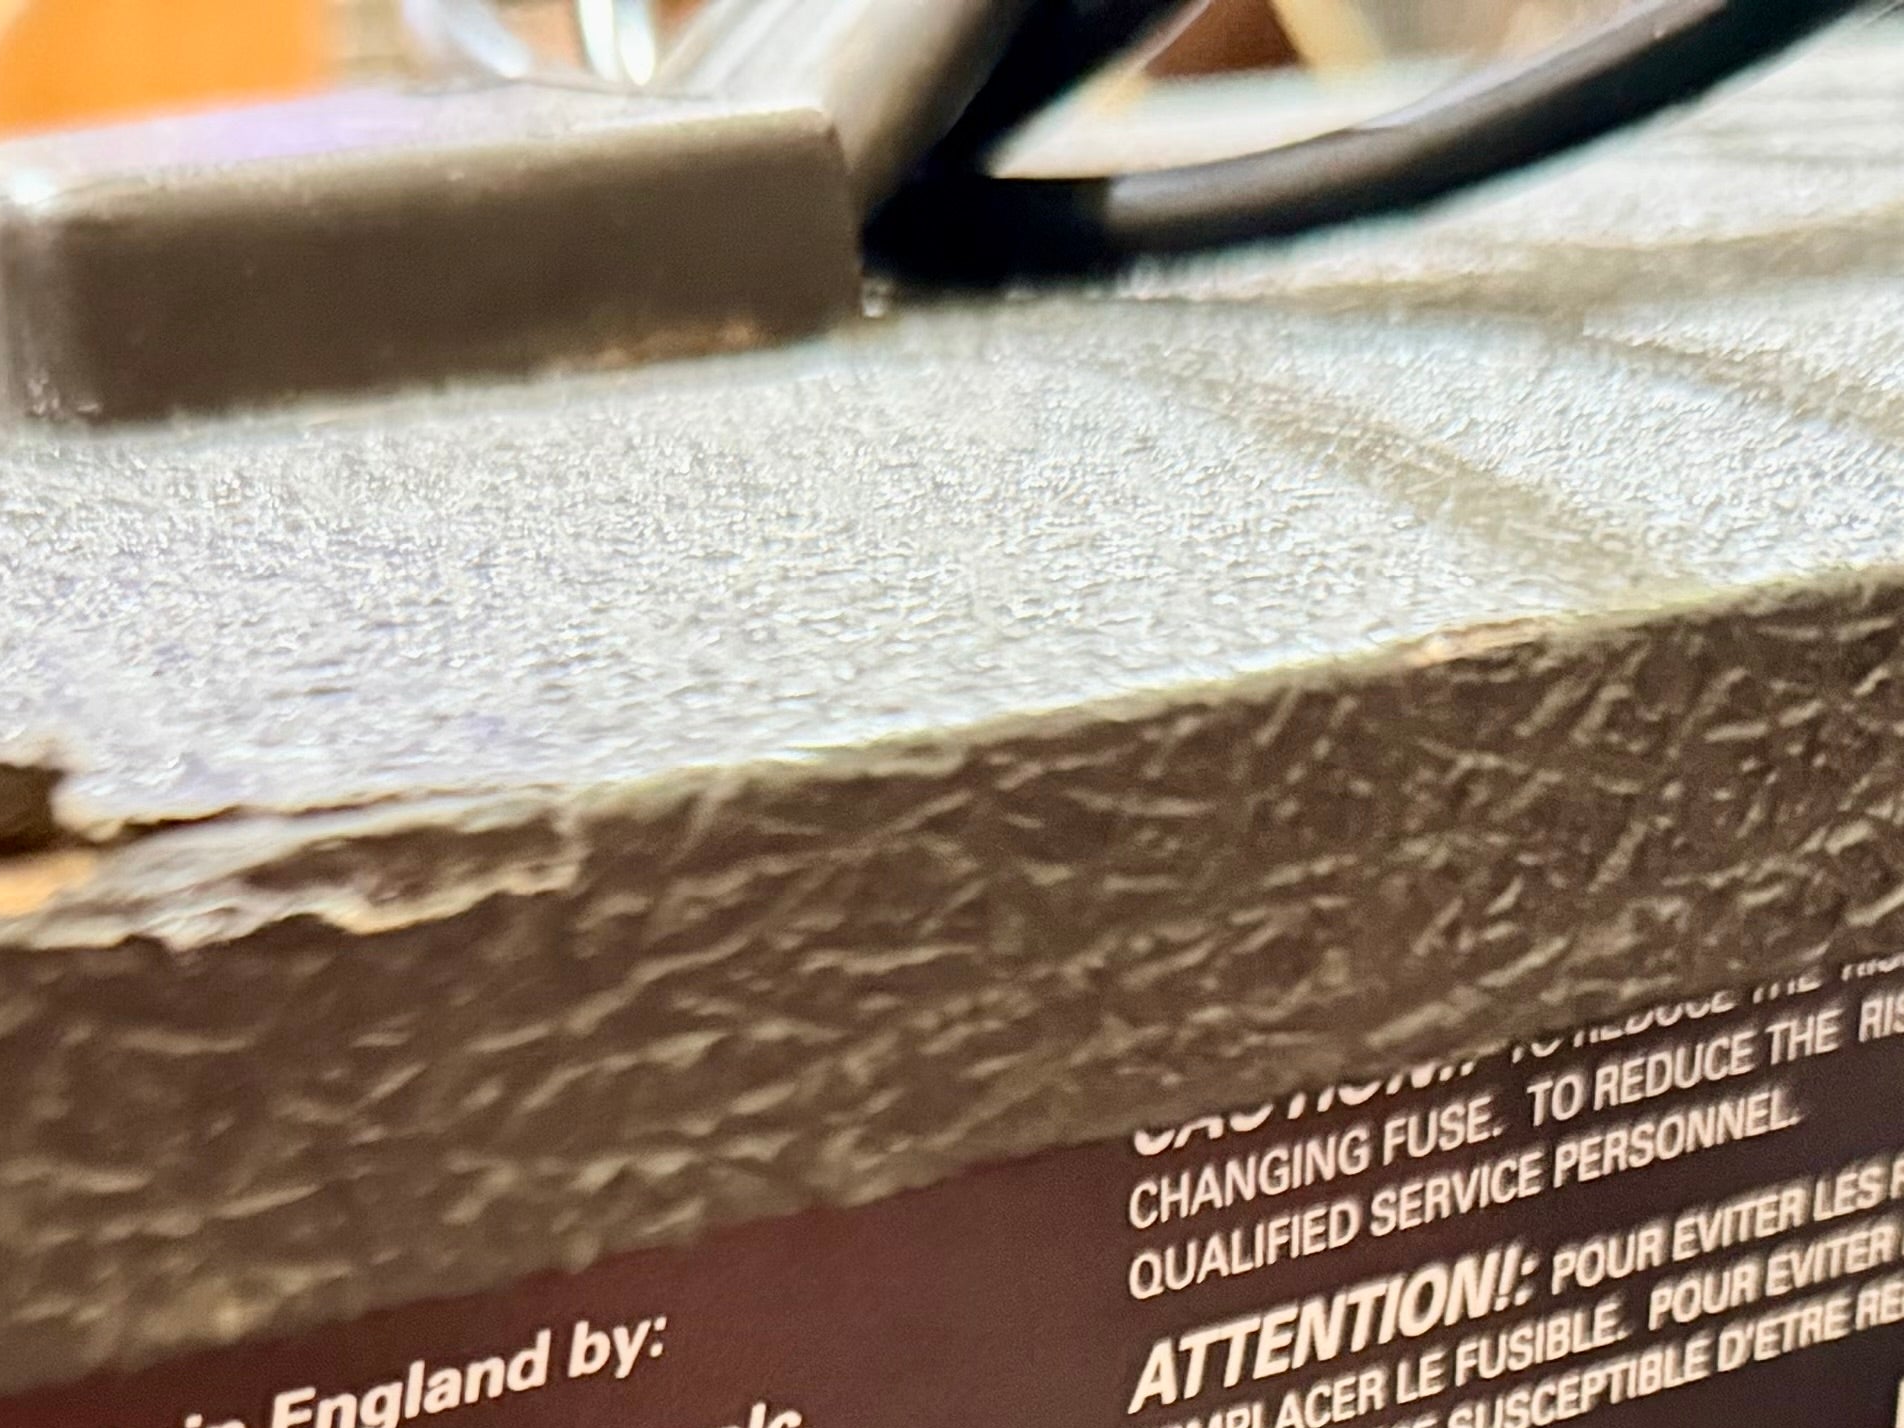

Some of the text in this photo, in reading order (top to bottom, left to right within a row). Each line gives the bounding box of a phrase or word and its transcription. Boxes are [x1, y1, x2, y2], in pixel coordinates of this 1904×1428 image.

[1128, 1129, 1370, 1230] CHANGING
[1382, 1095, 1504, 1165] FUSE.
[1526, 1070, 1584, 1127] TO
[1593, 1028, 1757, 1112] REDUCE
[1767, 1005, 1843, 1067] THE
[1128, 1199, 1360, 1300] QUALIFIED
[1370, 1151, 1543, 1237] SERVICE
[1552, 1087, 1804, 1188] PERSONNEL.
[1551, 1218, 1669, 1296] POUR
[1673, 1178, 1810, 1262] EVITER
[1813, 1157, 1891, 1222] LES
[567, 1315, 668, 1379] by:
[1396, 1344, 1447, 1407] LE
[1454, 1293, 1633, 1388] FUSIBLE.
[1648, 1256, 1765, 1332] POUR
[1764, 1215, 1900, 1298] EVITER
[1717, 1287, 1854, 1372] D'ETRE
